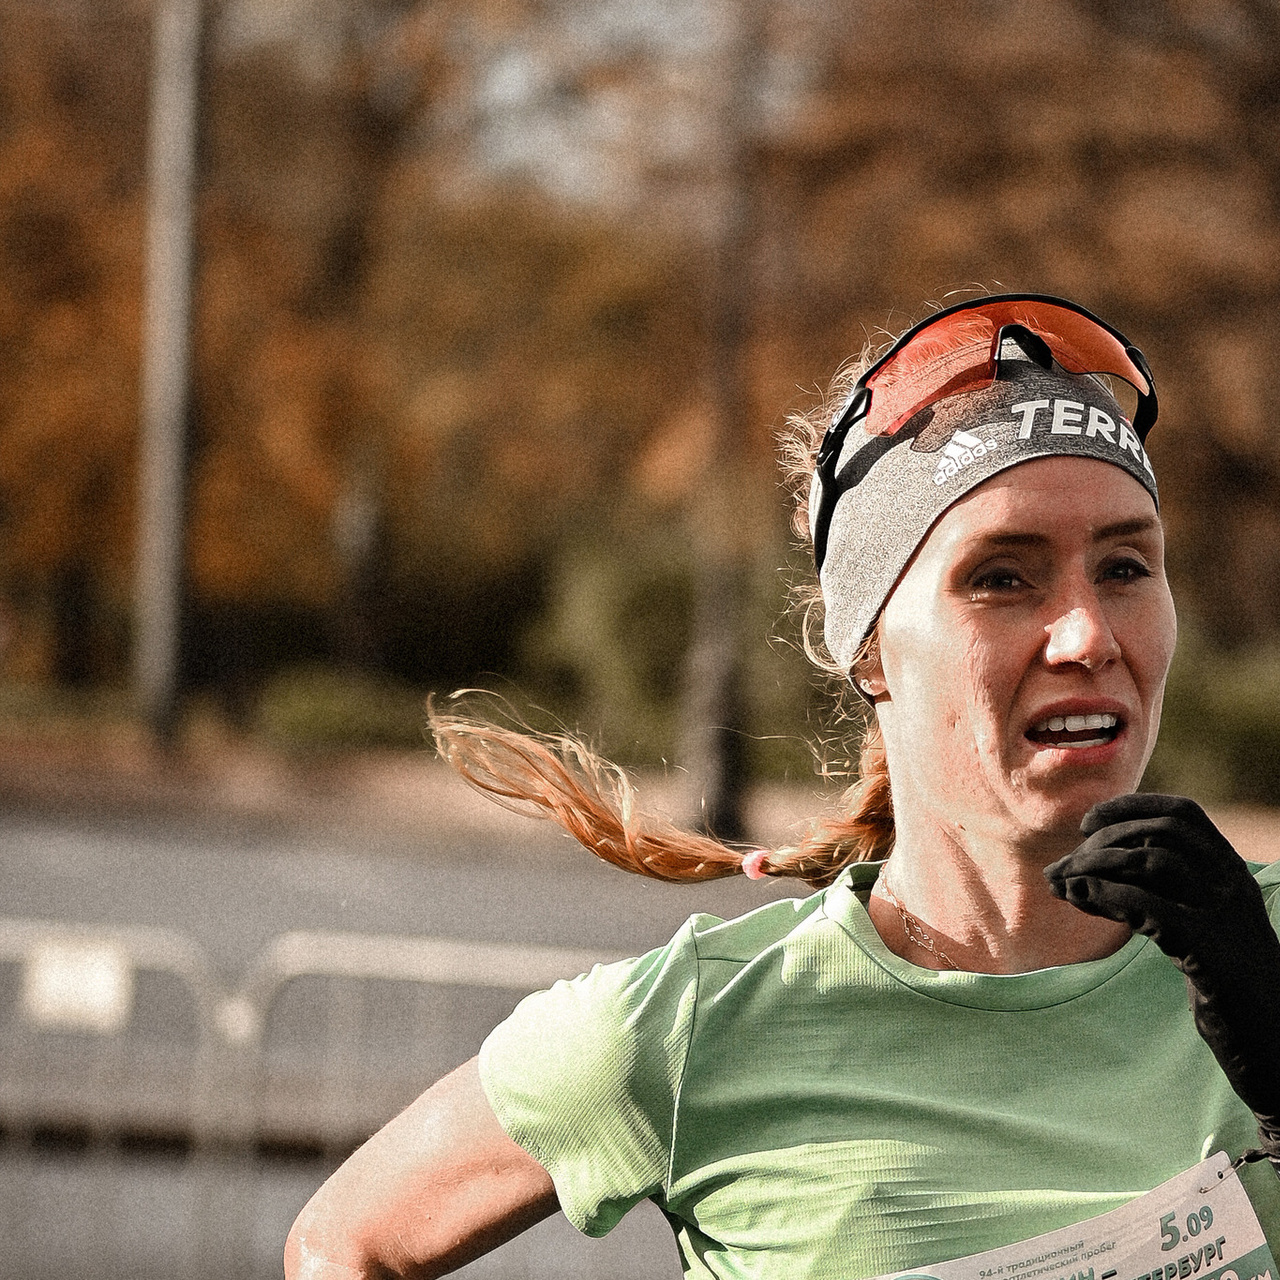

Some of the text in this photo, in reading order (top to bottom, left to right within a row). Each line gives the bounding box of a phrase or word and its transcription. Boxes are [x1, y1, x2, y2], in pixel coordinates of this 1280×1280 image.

[933, 437, 997, 486] adidas
[1160, 1205, 1213, 1251] 5.09
[979, 1240, 1085, 1280] 94-й традиционный
[1081, 1241, 1117, 1262] пробег
